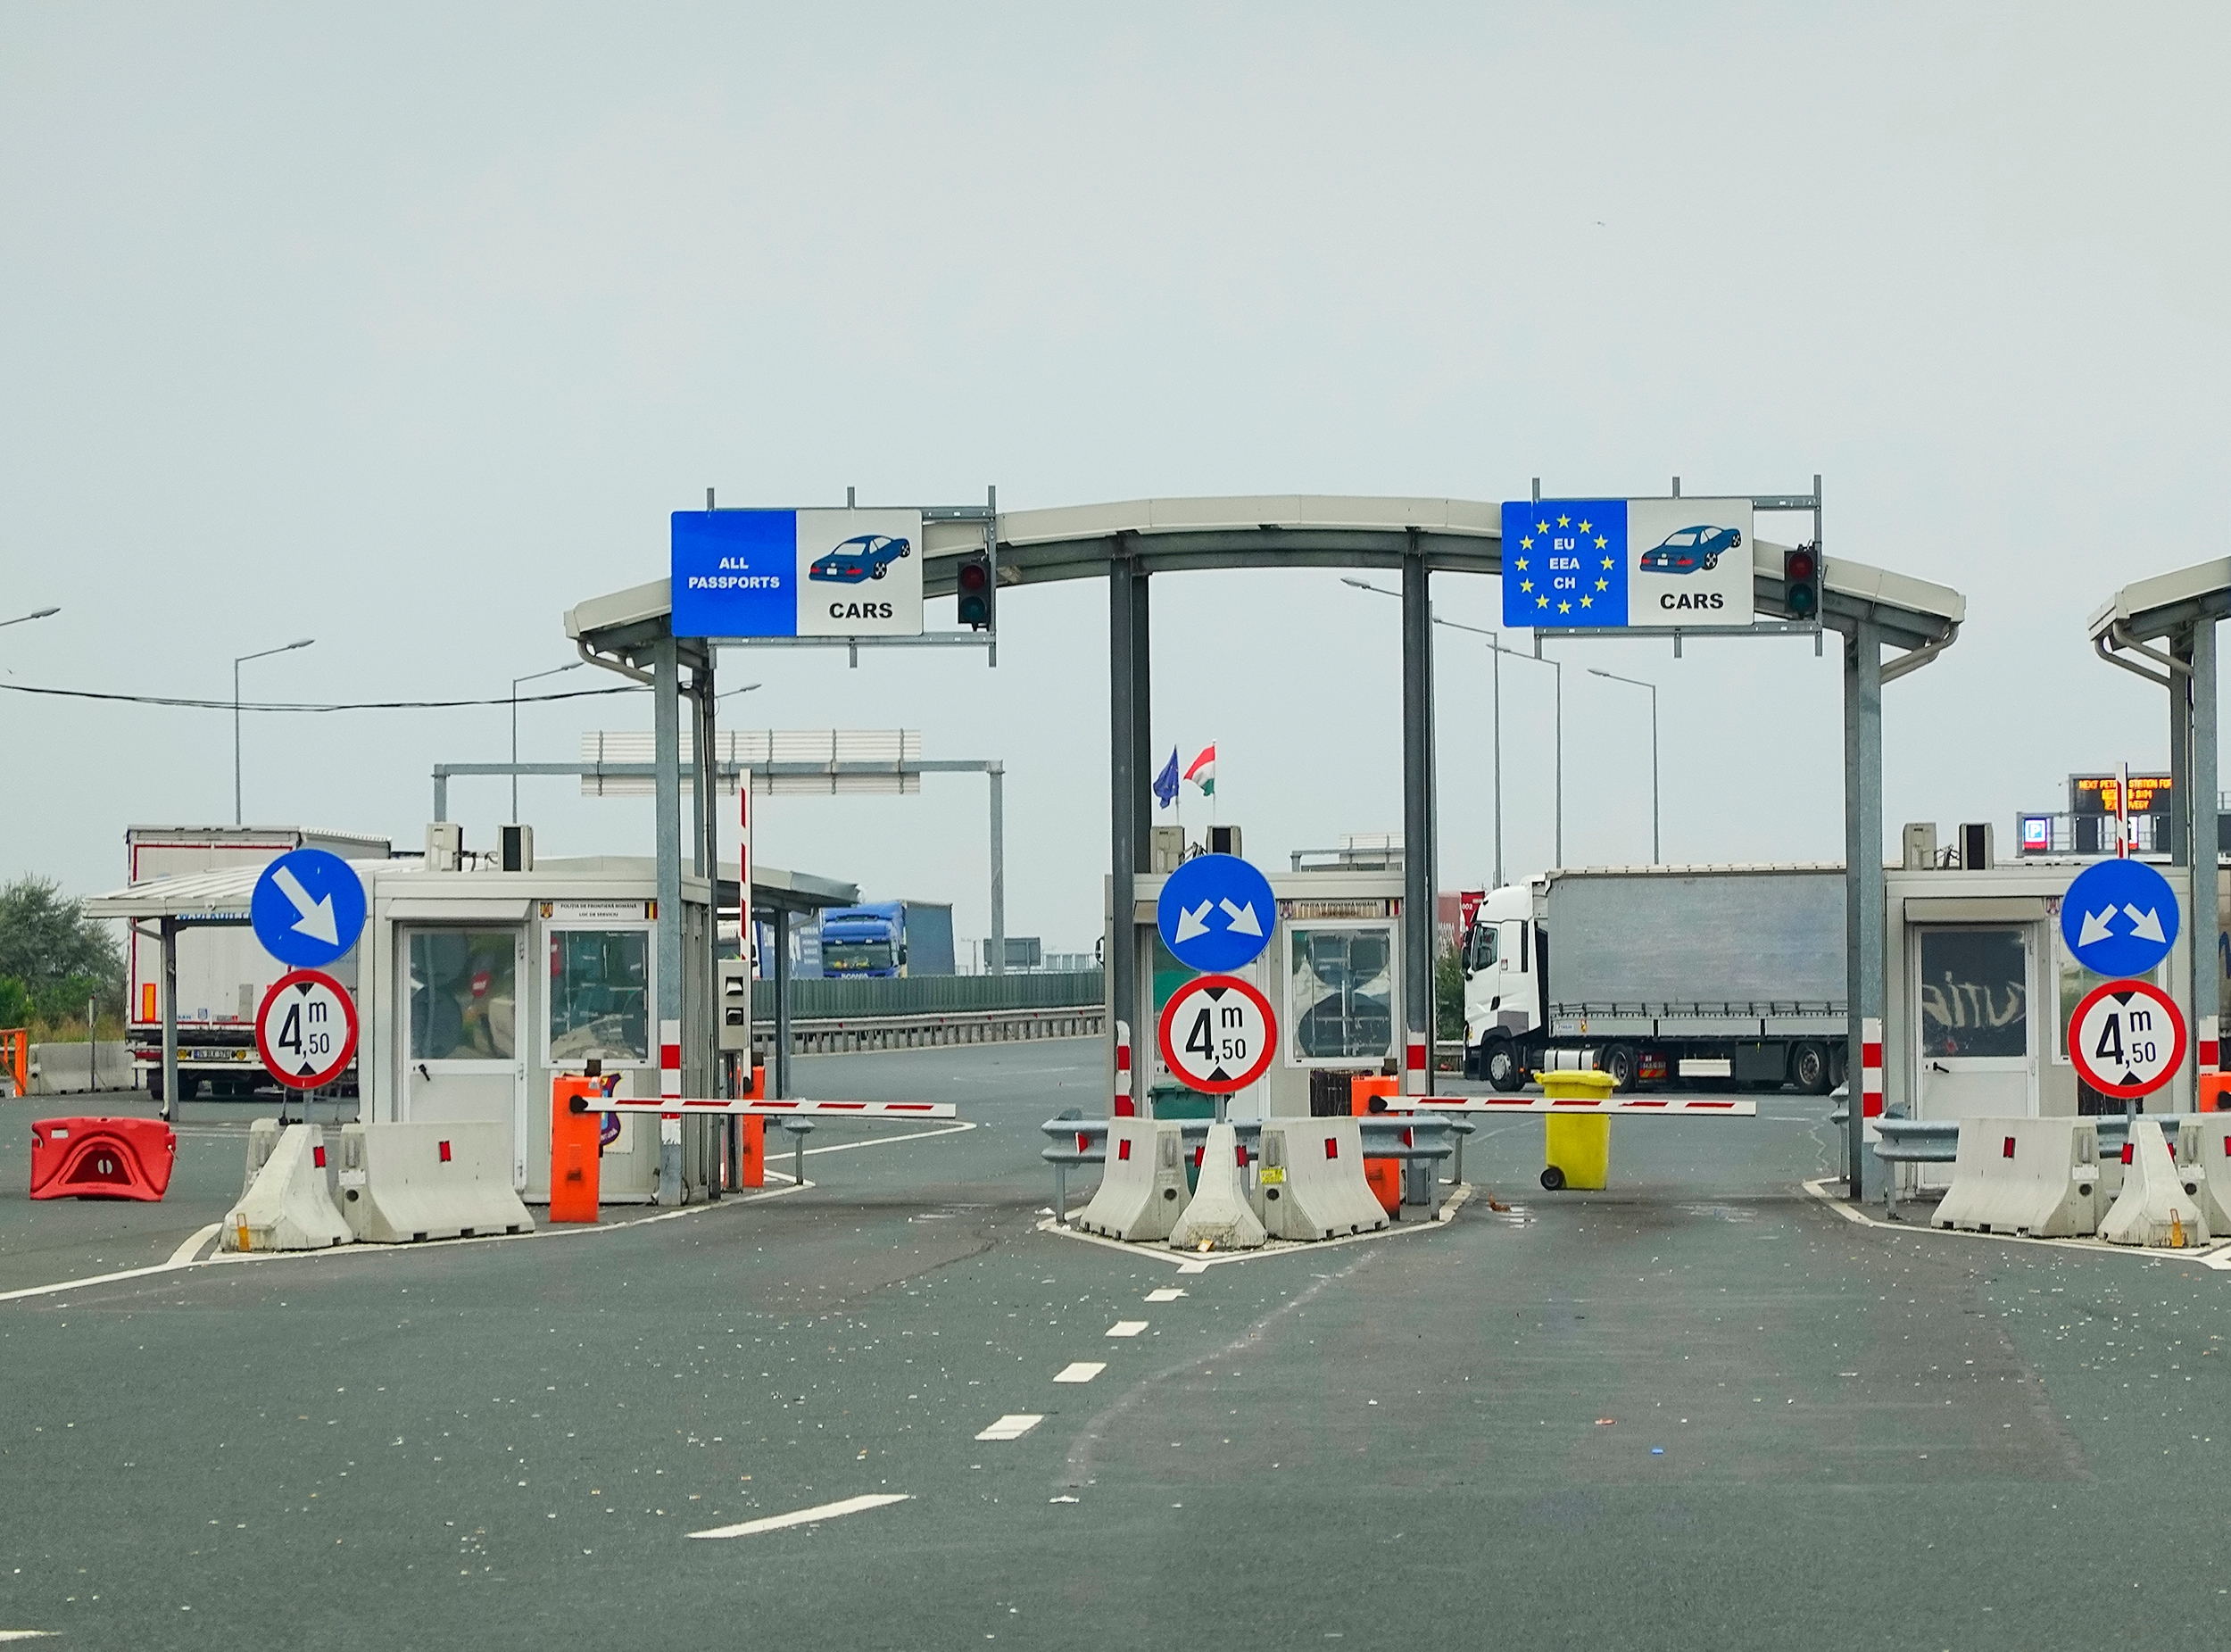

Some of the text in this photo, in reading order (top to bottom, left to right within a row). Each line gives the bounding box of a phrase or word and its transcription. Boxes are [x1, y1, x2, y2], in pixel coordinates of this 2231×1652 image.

[1554, 537, 1575, 551] EU
[718, 557, 749, 570] ALL
[1549, 557, 1580, 570] EEA
[688, 576, 780, 589] PASSPORTS
[1554, 577, 1576, 590] CH
[1660, 593, 1724, 610] CARS
[829, 602, 893, 619] CARS
[2078, 779, 2099, 790] NEXT
[2030, 824, 2041, 838] P
